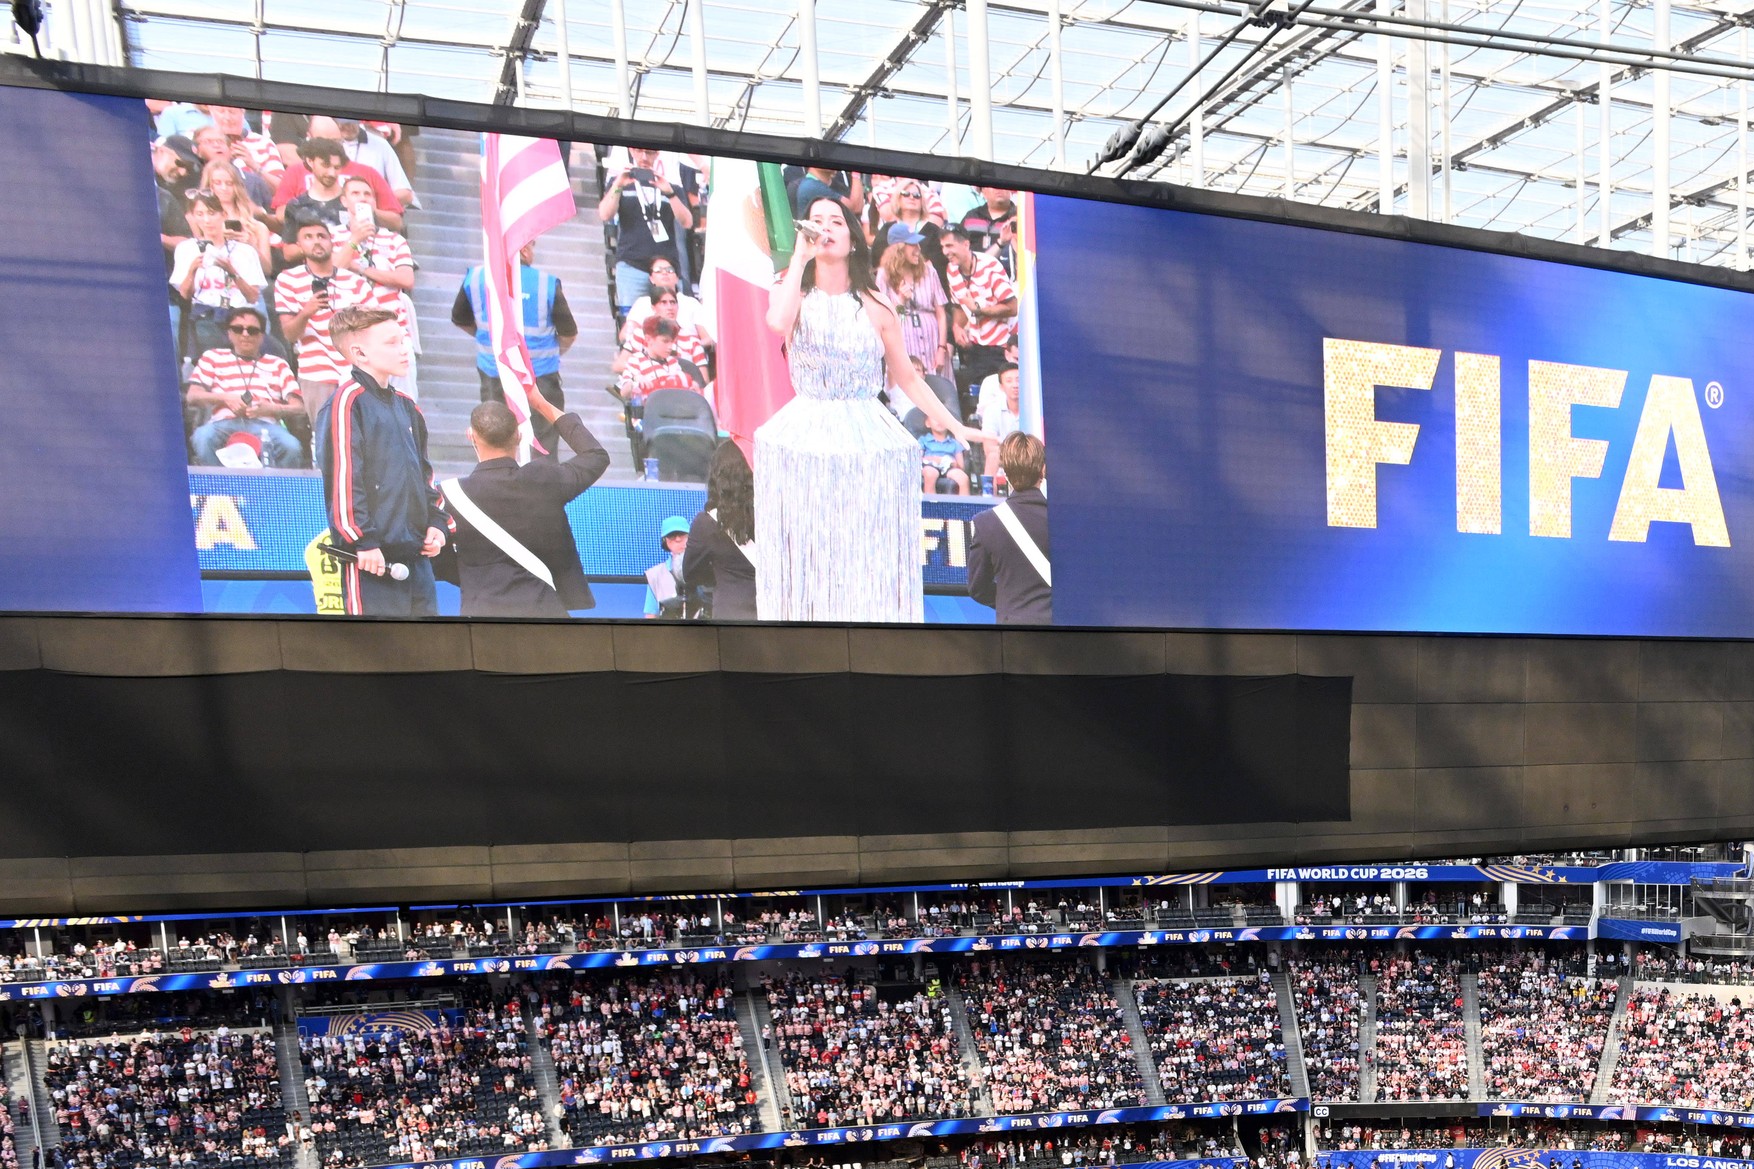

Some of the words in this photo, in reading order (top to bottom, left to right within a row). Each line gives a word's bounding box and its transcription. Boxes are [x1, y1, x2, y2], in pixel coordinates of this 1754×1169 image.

[191, 494, 259, 550] A
[921, 518, 975, 568] FI
[1267, 868, 1297, 880] FIFA
[1297, 868, 1349, 880] WORLD
[1350, 867, 1379, 879] CUP
[1380, 867, 1429, 880] 2026
[1322, 929, 1341, 937] FIFA
[1525, 928, 1544, 937] FIFA
[1640, 927, 1677, 937] #FIFAWorldCup
[1001, 938, 1021, 947] FIFA
[828, 945, 850, 954] FIFA
[646, 953, 670, 962] FIFA
[453, 962, 477, 972] FIFA
[245, 973, 272, 983] FIFA
[21, 985, 49, 996] FIFA
[1315, 1108, 1328, 1116] CC
[1688, 1112, 1707, 1121] FIFA
[1010, 1118, 1033, 1128] FIFA
[1067, 1114, 1089, 1124] FIFA
[817, 1131, 841, 1142] FIFA
[877, 1127, 901, 1137] FIFA
[611, 1147, 636, 1158] FIFA
[1666, 1157, 1700, 1168] LOS
